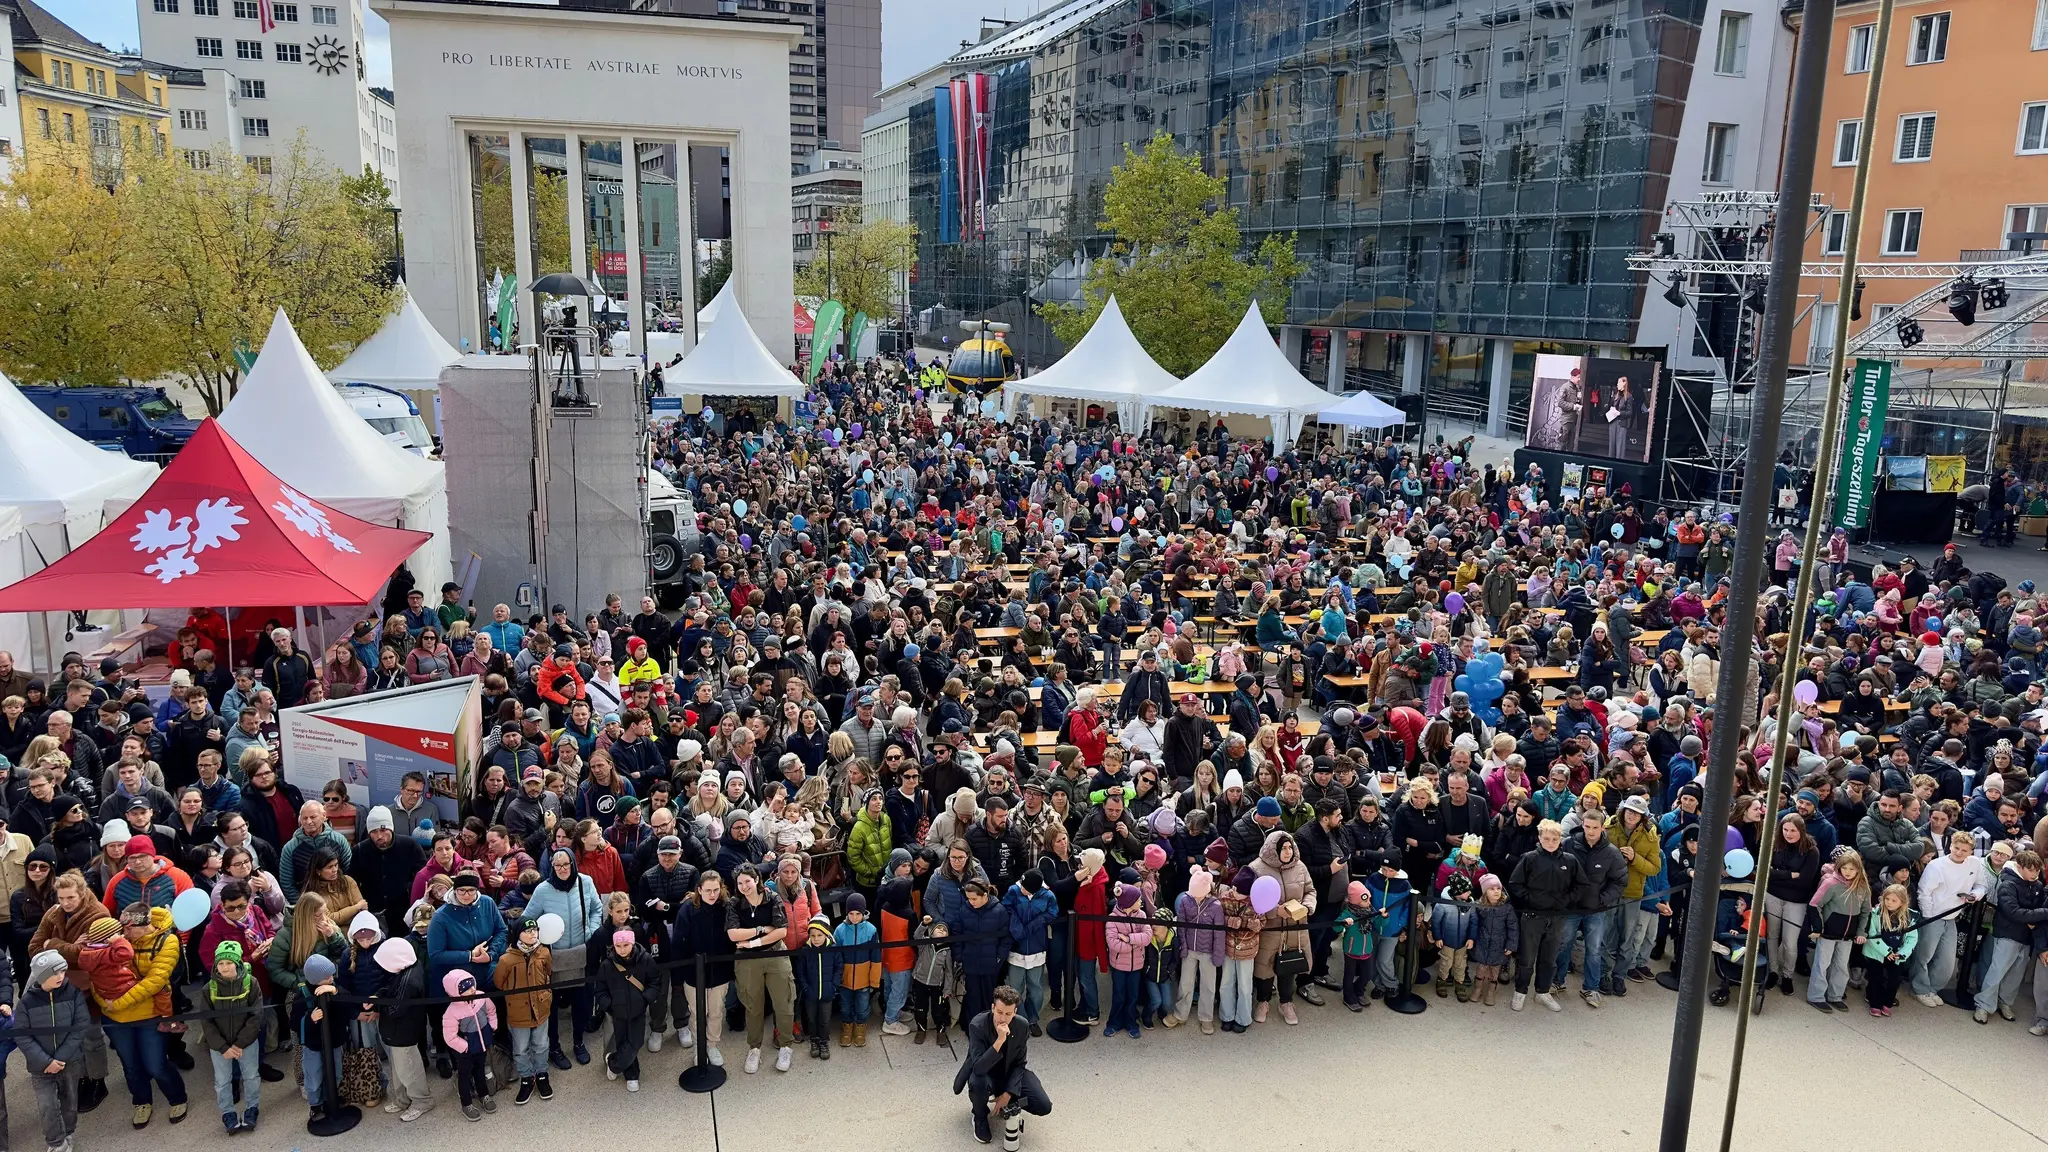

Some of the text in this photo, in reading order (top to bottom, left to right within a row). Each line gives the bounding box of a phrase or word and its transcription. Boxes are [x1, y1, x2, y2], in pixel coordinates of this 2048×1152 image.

[442, 52, 743, 80] PRO LIBERTATE AVSTRIAE MORTVIS
[1843, 365, 1881, 526] Tiroler Tageszeitung
[306, 734, 333, 742] fondamentali
